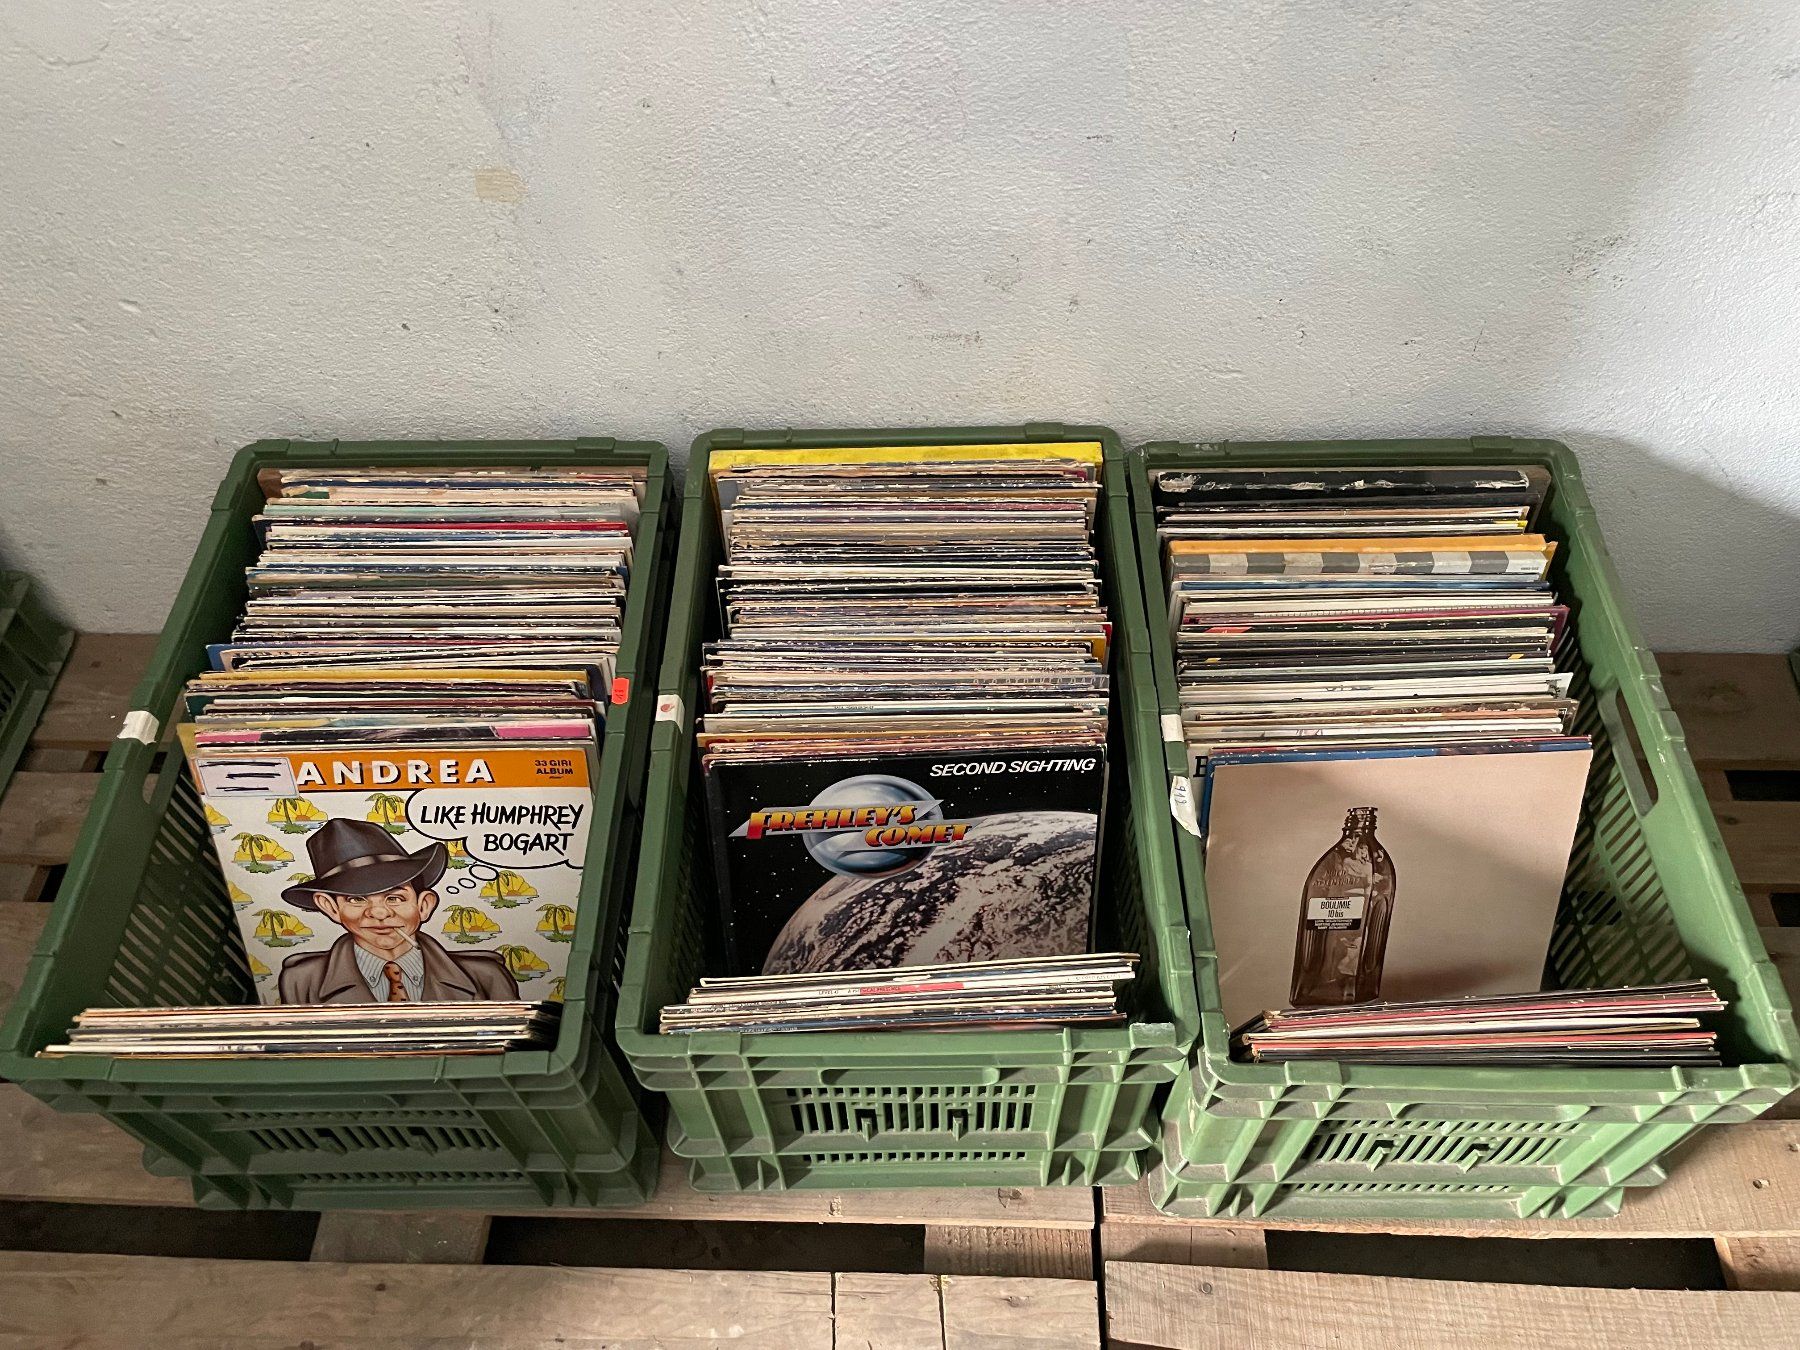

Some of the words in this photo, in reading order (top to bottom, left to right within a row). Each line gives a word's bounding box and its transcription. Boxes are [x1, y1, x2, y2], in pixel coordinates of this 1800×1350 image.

[296, 758, 496, 785] ANDREA
[930, 762, 1006, 777] SECOND
[1008, 758, 1096, 773] SIGHTING
[420, 805, 466, 830] LIKE
[471, 802, 584, 831] HUMPHREY
[746, 805, 917, 839] FREHLEY'S
[484, 833, 574, 856] BOGART
[864, 824, 972, 847] COMET
[1320, 901, 1351, 910] BOULIMIE
